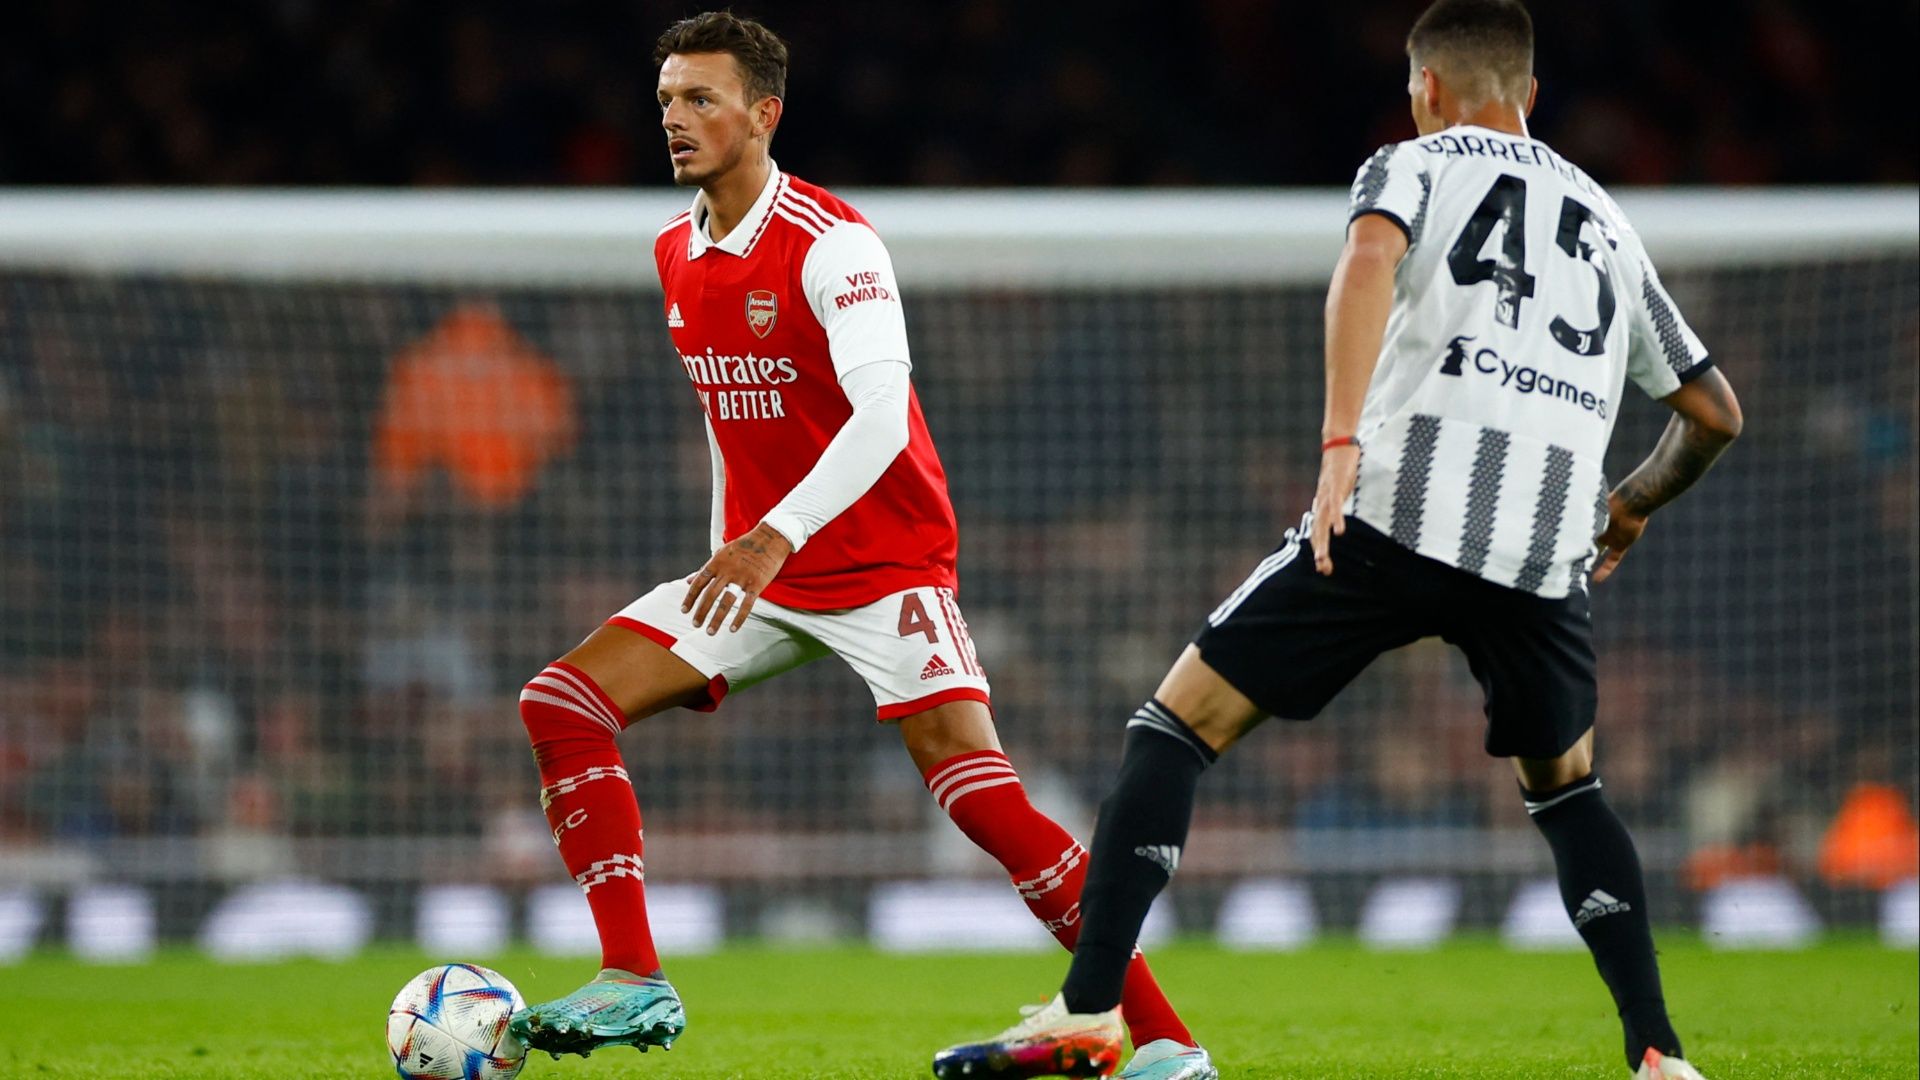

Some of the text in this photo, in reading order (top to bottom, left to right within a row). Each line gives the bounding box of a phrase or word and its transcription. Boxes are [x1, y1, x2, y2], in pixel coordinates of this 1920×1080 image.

[845, 271, 881, 288] VISIT
[1447, 173, 1617, 356] 45
[675, 346, 798, 385] mirates
[1474, 348, 1607, 420] Cygames
[717, 389, 786, 420] BETTER
[897, 592, 939, 644] 4
[920, 667, 955, 680] adidas
[552, 808, 588, 847] FC
